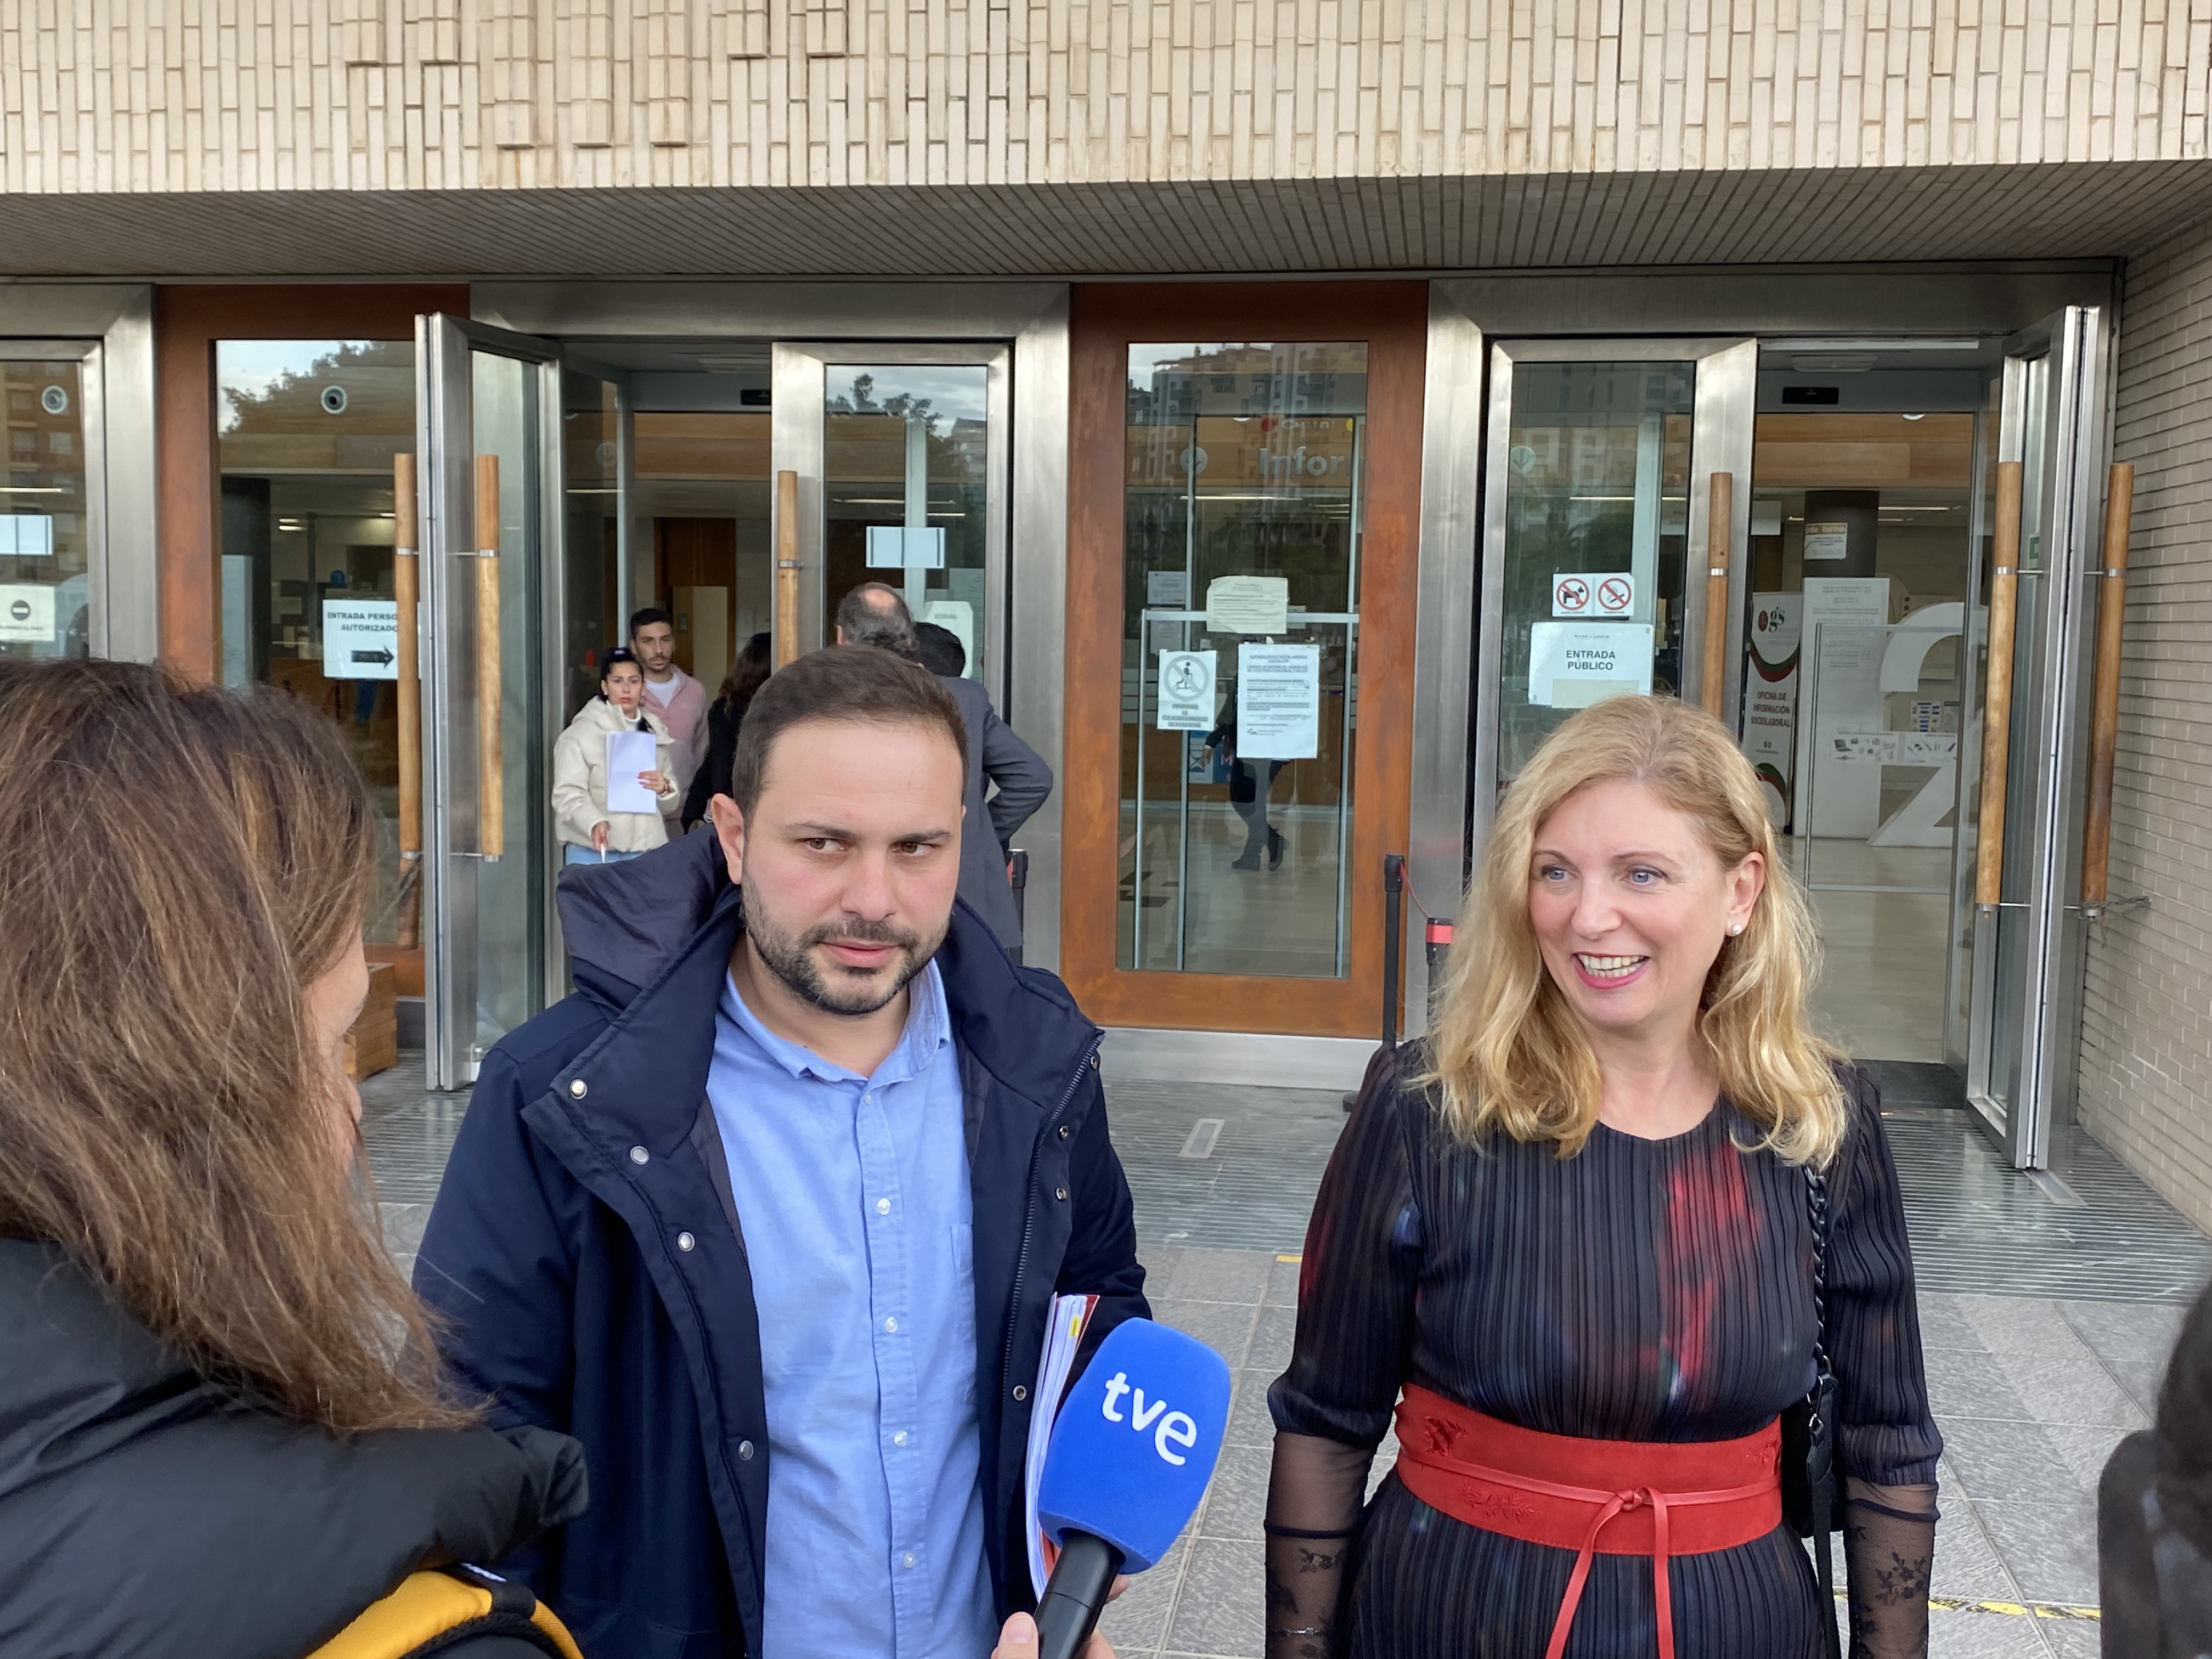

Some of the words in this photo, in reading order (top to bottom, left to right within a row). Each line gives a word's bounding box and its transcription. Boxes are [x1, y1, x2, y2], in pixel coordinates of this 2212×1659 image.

[1259, 445, 1364, 477] Infor
[1566, 650, 1616, 659] ENTRADA
[1567, 659, 1613, 670] PÚBLICO
[1757, 691, 1778, 701] OFICINA
[1778, 692, 1787, 701] DE
[1750, 715, 1790, 727] SOCIOLABORAL
[1101, 1372, 1198, 1466] tve
